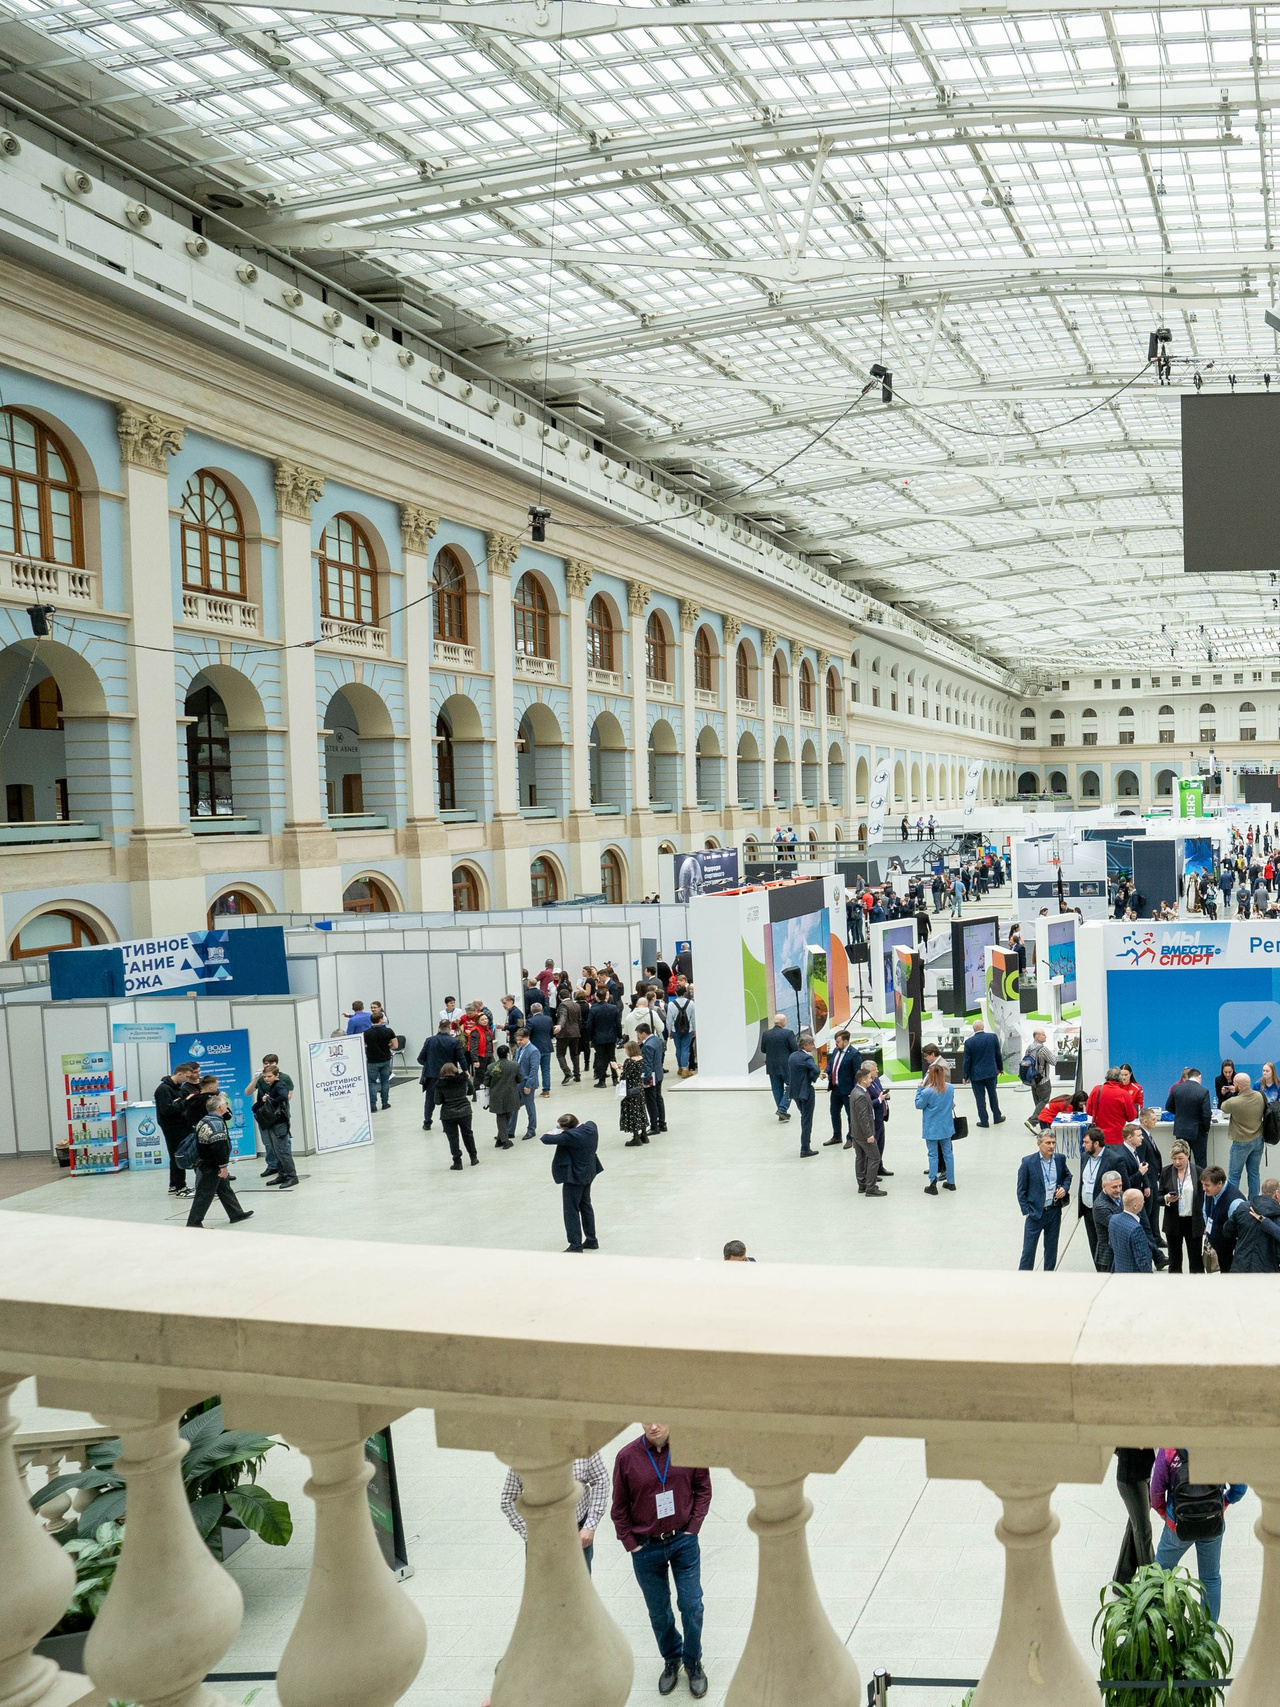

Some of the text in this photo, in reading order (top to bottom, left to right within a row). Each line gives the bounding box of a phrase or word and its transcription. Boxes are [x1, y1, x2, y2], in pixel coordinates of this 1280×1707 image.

[1162, 931, 1200, 945] МЫ
[1160, 945, 1215, 955] ВМЕСТЕ
[123, 956, 175, 975] ТАНИЕ
[1159, 954, 1214, 966] СПОРТ
[124, 974, 163, 992] ОЖА
[206, 1044, 232, 1052] ВОДЫ
[315, 1075, 363, 1089] СПОРТИВНОЕ
[323, 1082, 356, 1093] МЕТАНИЕ
[329, 1089, 352, 1098] НОЖА
